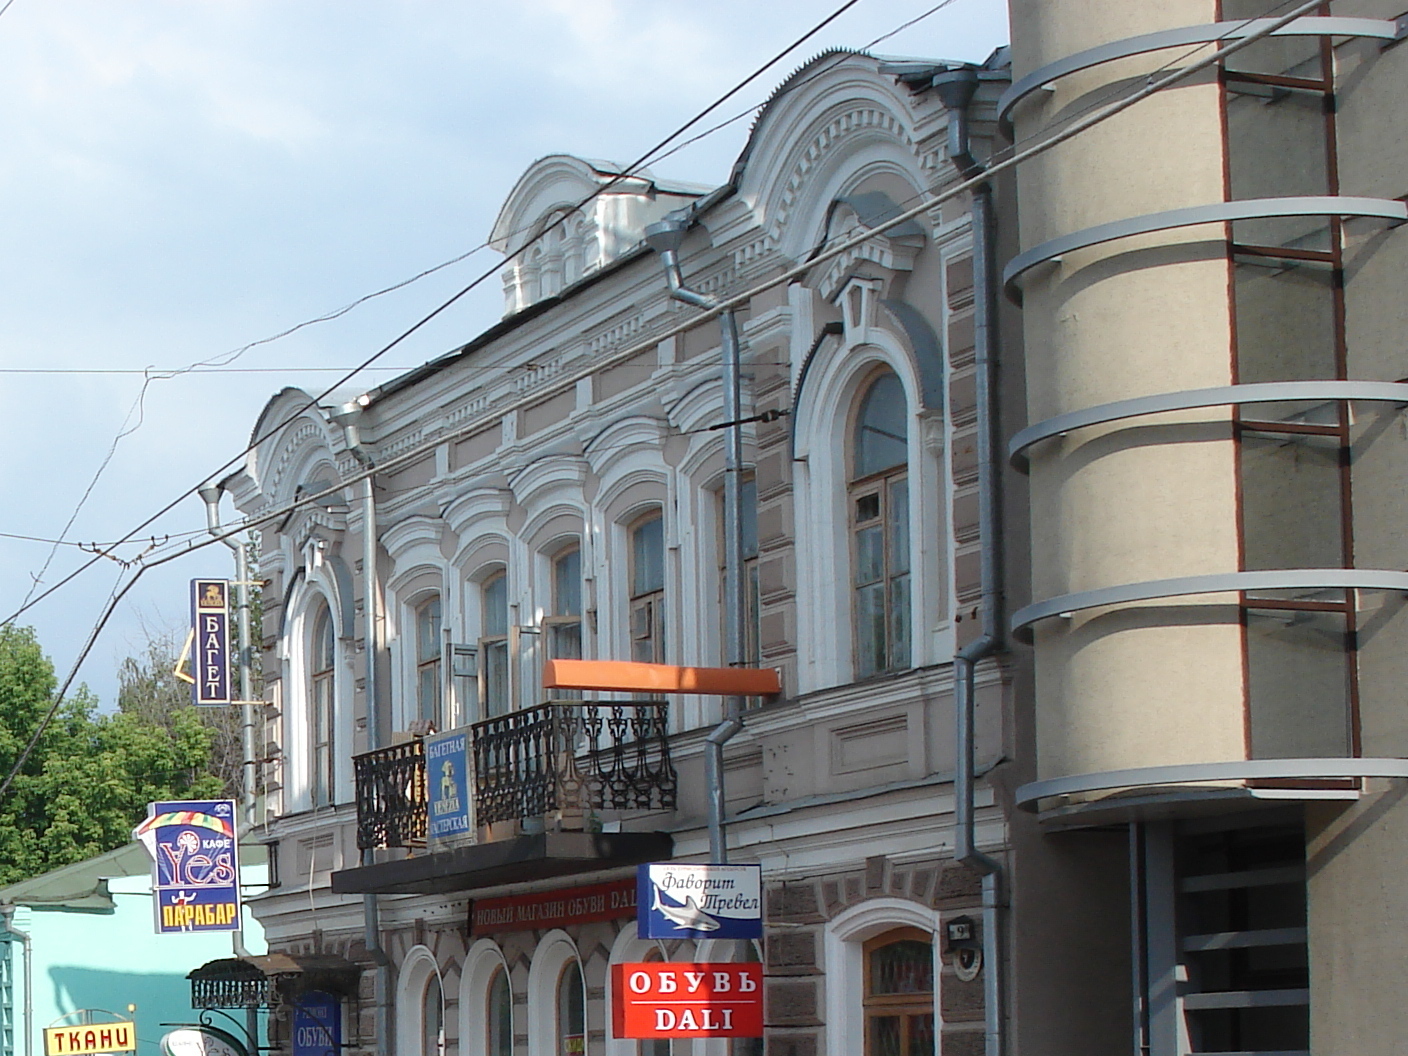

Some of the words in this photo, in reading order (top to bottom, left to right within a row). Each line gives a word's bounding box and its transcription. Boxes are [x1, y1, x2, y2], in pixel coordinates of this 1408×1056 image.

[205, 616, 220, 698] БАГЕТ
[429, 737, 466, 760] БАГЕТНАЯ
[202, 838, 231, 849] КАФЕ
[159, 832, 235, 886] Yes
[662, 872, 735, 894] Фаворит
[162, 903, 236, 927] ПАРАБАР
[476, 904, 513, 926] НОВЫЙ
[516, 901, 565, 922] МАГАЗИН
[568, 895, 605, 917] ОБУВИ
[700, 893, 759, 915] Тревел
[629, 971, 757, 994] ОБУВЬ
[654, 1009, 733, 1031] DALI
